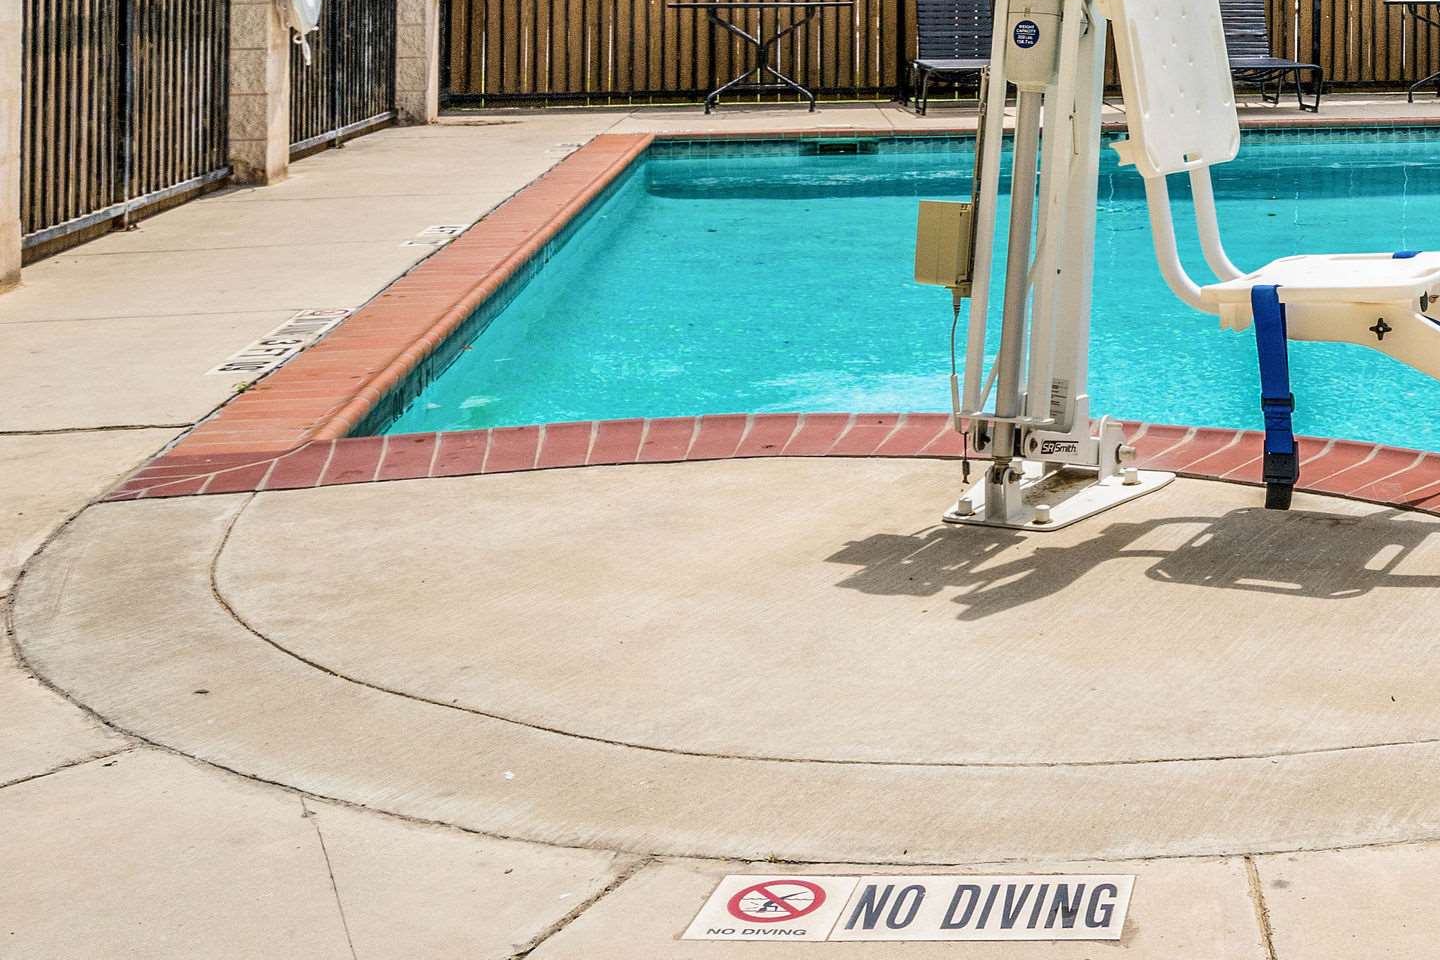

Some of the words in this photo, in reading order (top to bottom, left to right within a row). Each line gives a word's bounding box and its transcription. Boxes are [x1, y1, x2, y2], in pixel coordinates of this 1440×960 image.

[844, 884, 927, 930] NO
[939, 883, 1119, 930] DIVING
[706, 928, 736, 936] NO
[741, 928, 808, 936] DIVING
